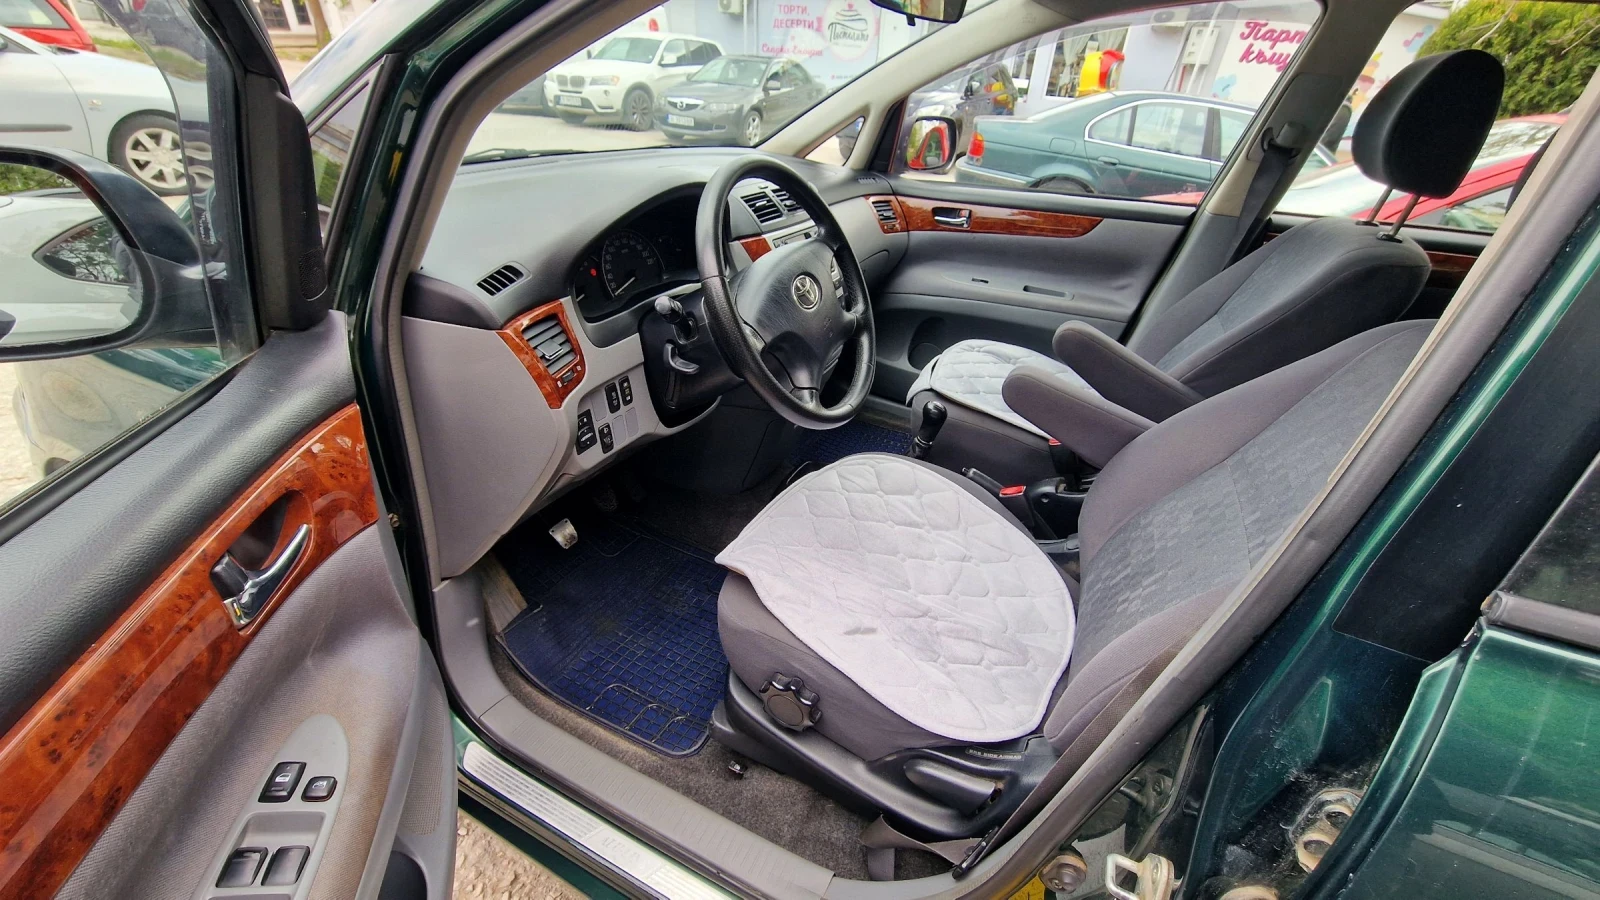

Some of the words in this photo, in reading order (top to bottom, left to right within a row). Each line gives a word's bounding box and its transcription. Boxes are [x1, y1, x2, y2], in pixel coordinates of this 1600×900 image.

[778, 4, 810, 16] ТОРТИ,
[773, 18, 815, 30] ДЕСЕРТИ
[1239, 21, 1307, 50] Парт
[1239, 43, 1292, 72] къщ
